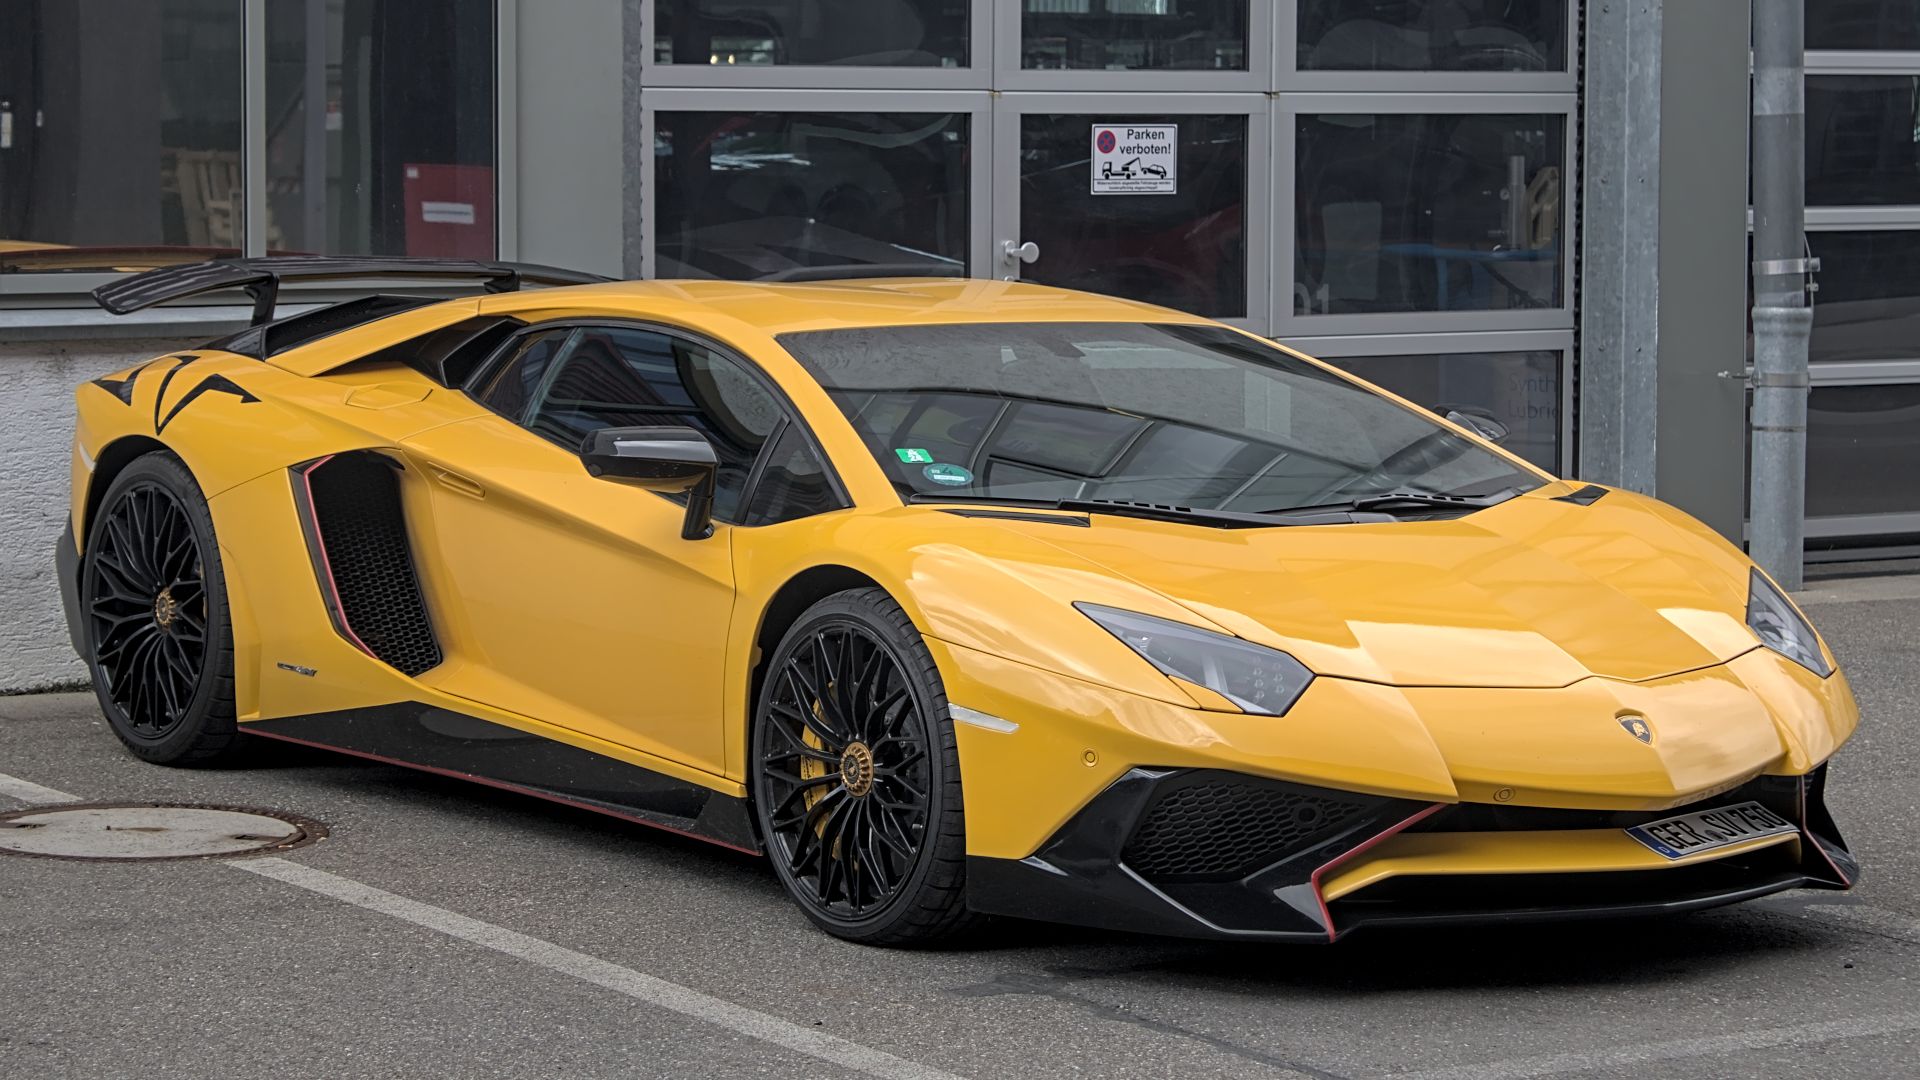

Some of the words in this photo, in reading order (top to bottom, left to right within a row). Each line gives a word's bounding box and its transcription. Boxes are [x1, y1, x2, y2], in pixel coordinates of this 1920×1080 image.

[1127, 128, 1165, 140] Parken
[1120, 143, 1171, 154] verboten!
[1647, 820, 1714, 850] GER
